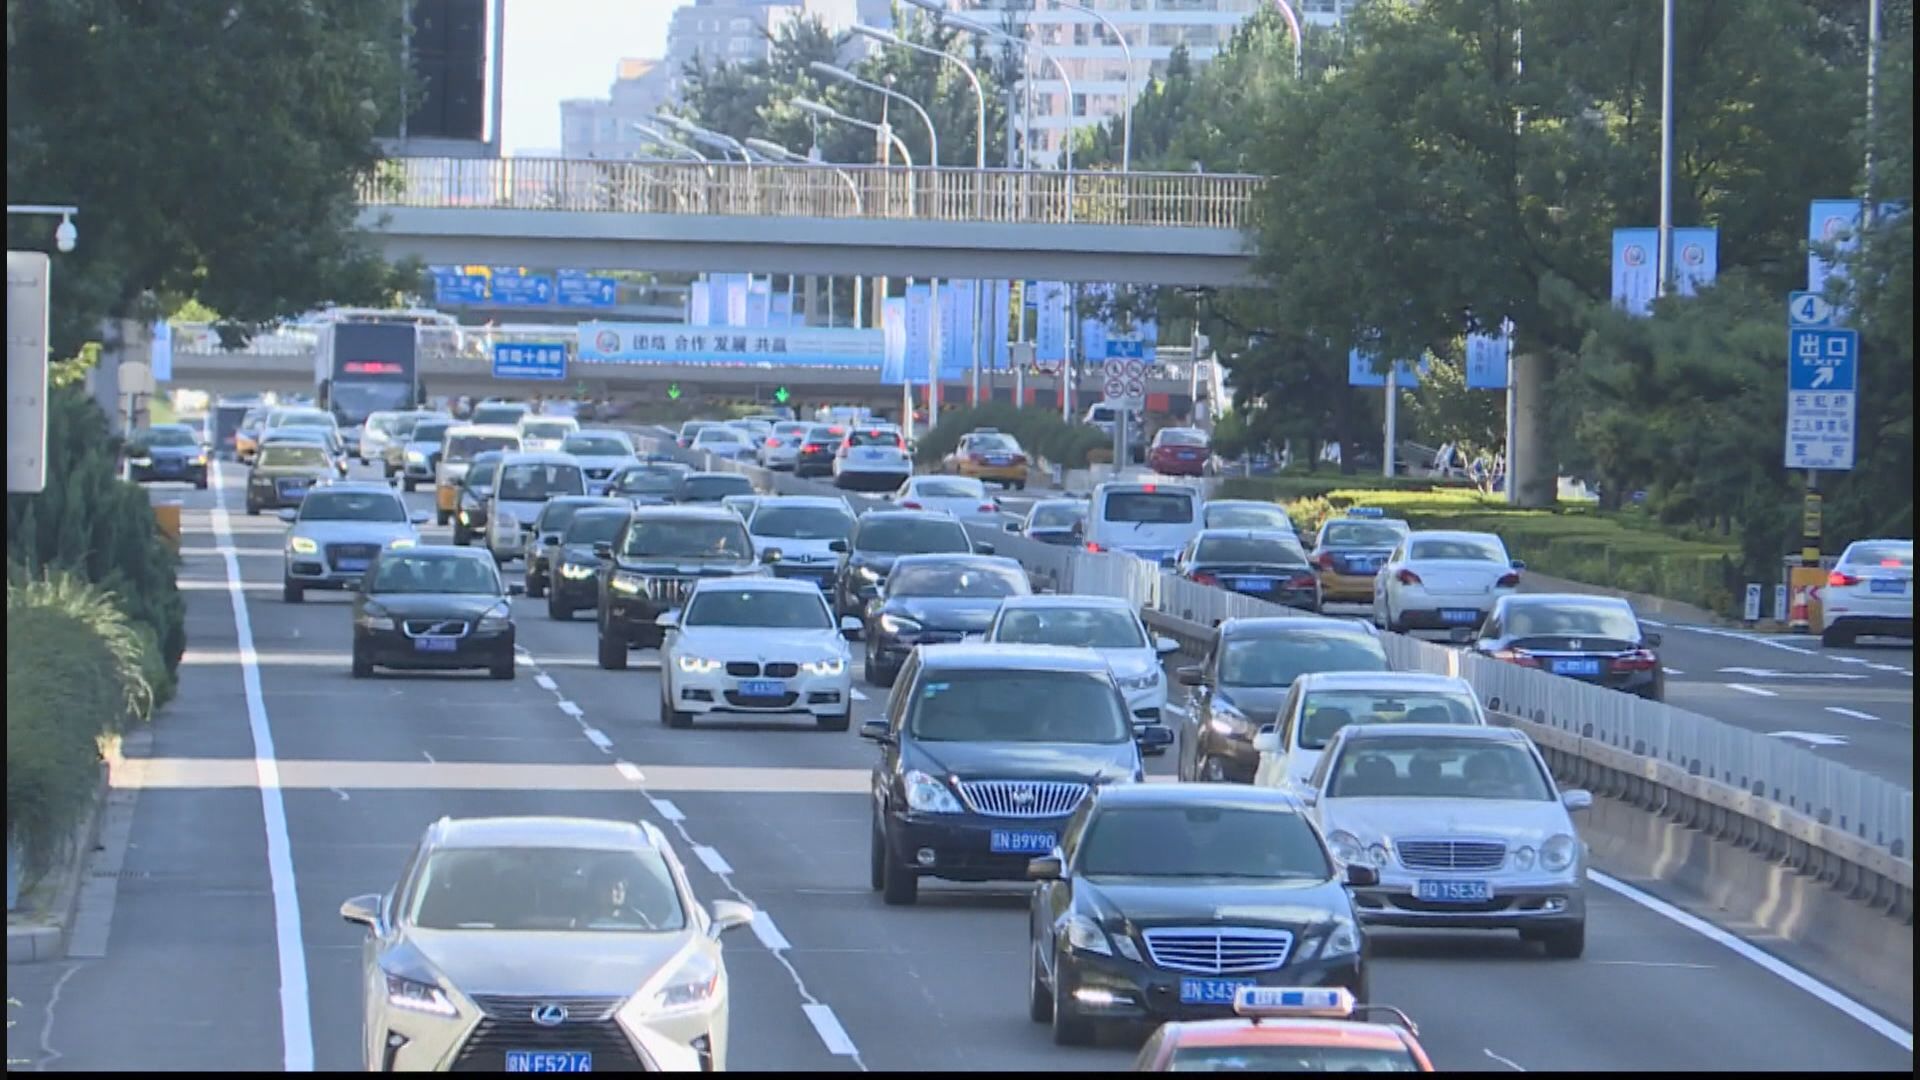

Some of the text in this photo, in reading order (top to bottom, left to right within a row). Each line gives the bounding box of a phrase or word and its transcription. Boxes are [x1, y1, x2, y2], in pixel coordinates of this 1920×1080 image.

[1801, 297, 1816, 320] 4
[674, 335, 707, 352] 合作
[1798, 334, 1848, 358] 出口
[1803, 358, 1842, 367] EXIT
